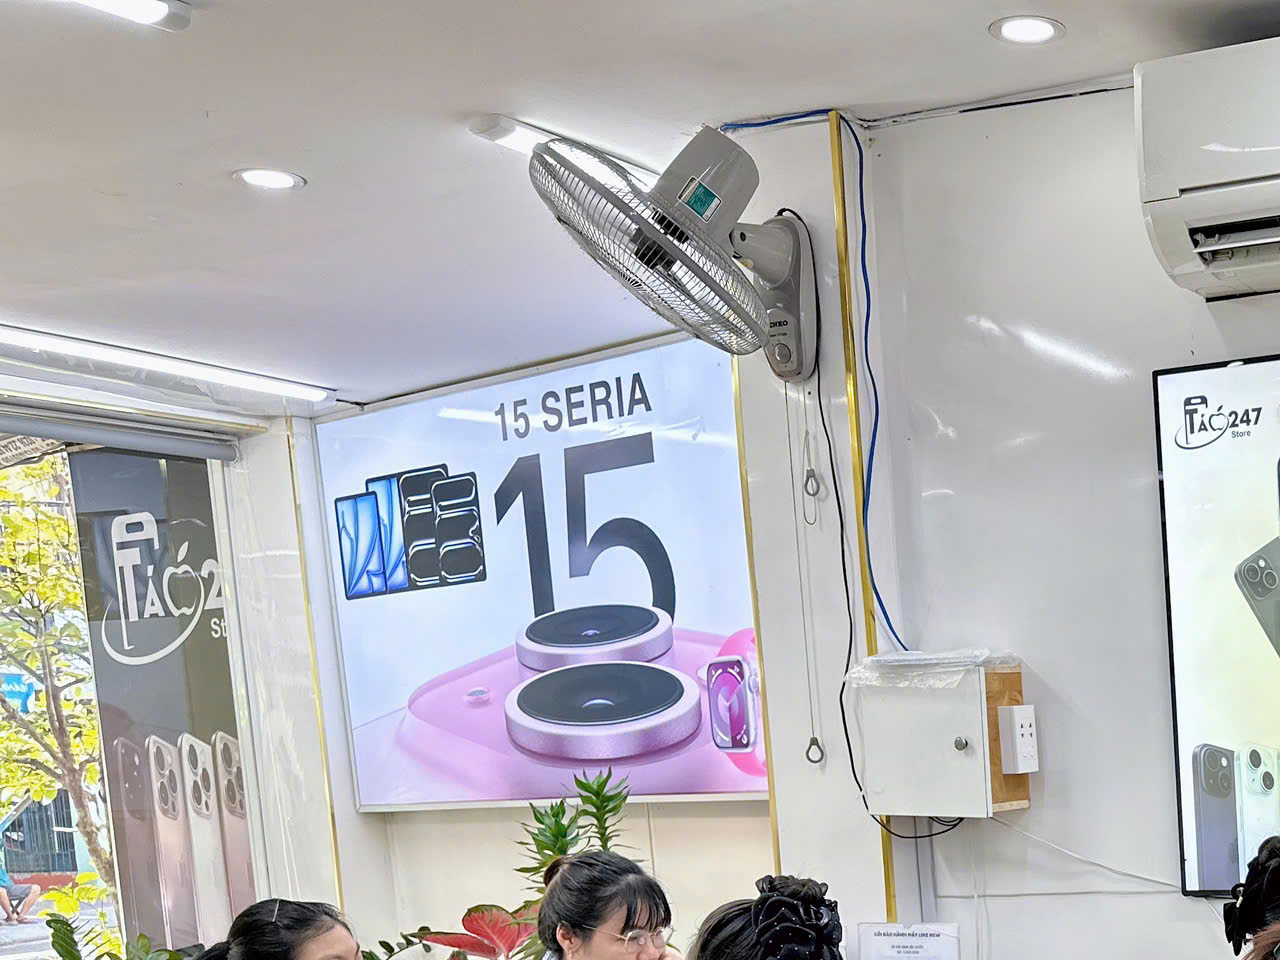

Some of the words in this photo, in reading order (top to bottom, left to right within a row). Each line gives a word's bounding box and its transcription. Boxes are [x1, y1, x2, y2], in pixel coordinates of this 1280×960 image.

[494, 398, 531, 441] 15
[541, 372, 653, 432] SERIA
[1231, 430, 1252, 438] Store
[494, 431, 677, 626] 15
